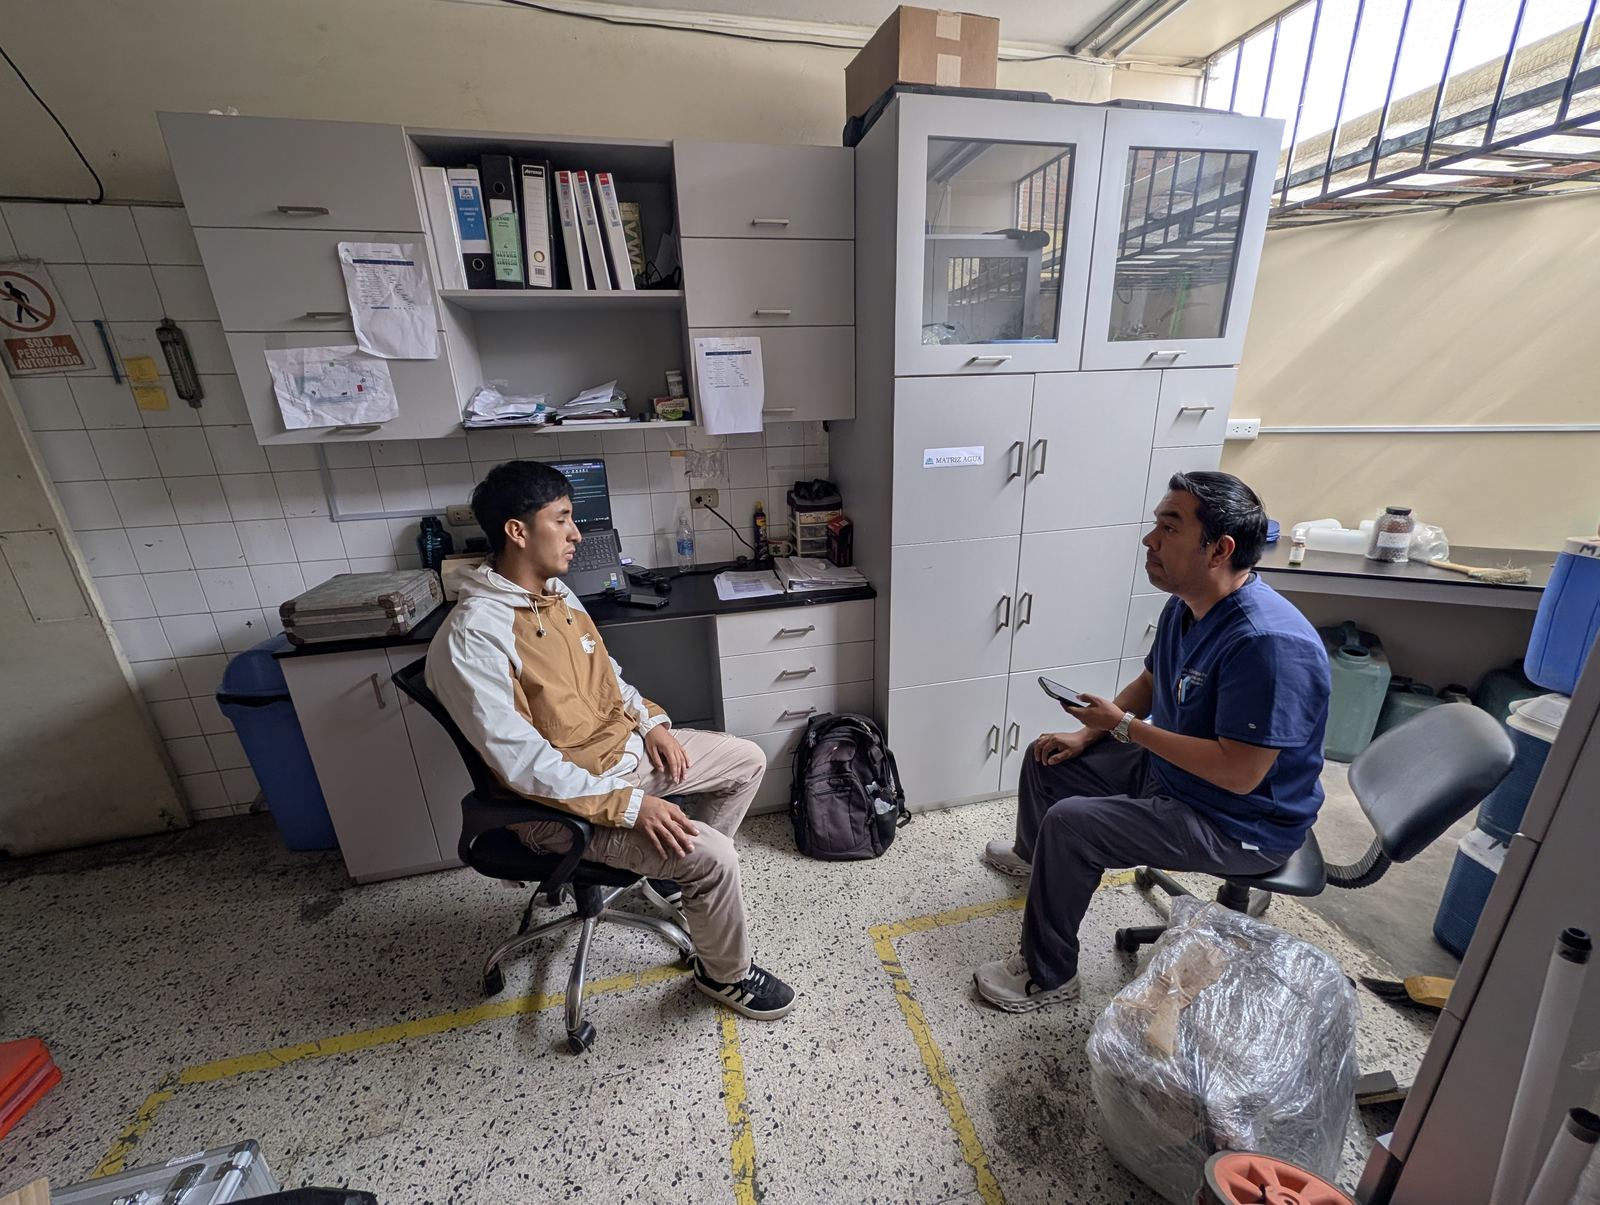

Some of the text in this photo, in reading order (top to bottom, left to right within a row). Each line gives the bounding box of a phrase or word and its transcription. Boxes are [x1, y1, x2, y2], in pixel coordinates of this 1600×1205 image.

[25, 337, 53, 348] SOLO
[17, 346, 72, 359] PERSONAL
[17, 355, 81, 369] AUTORIZADO
[935, 455, 982, 464] MATRIZ AGUA
